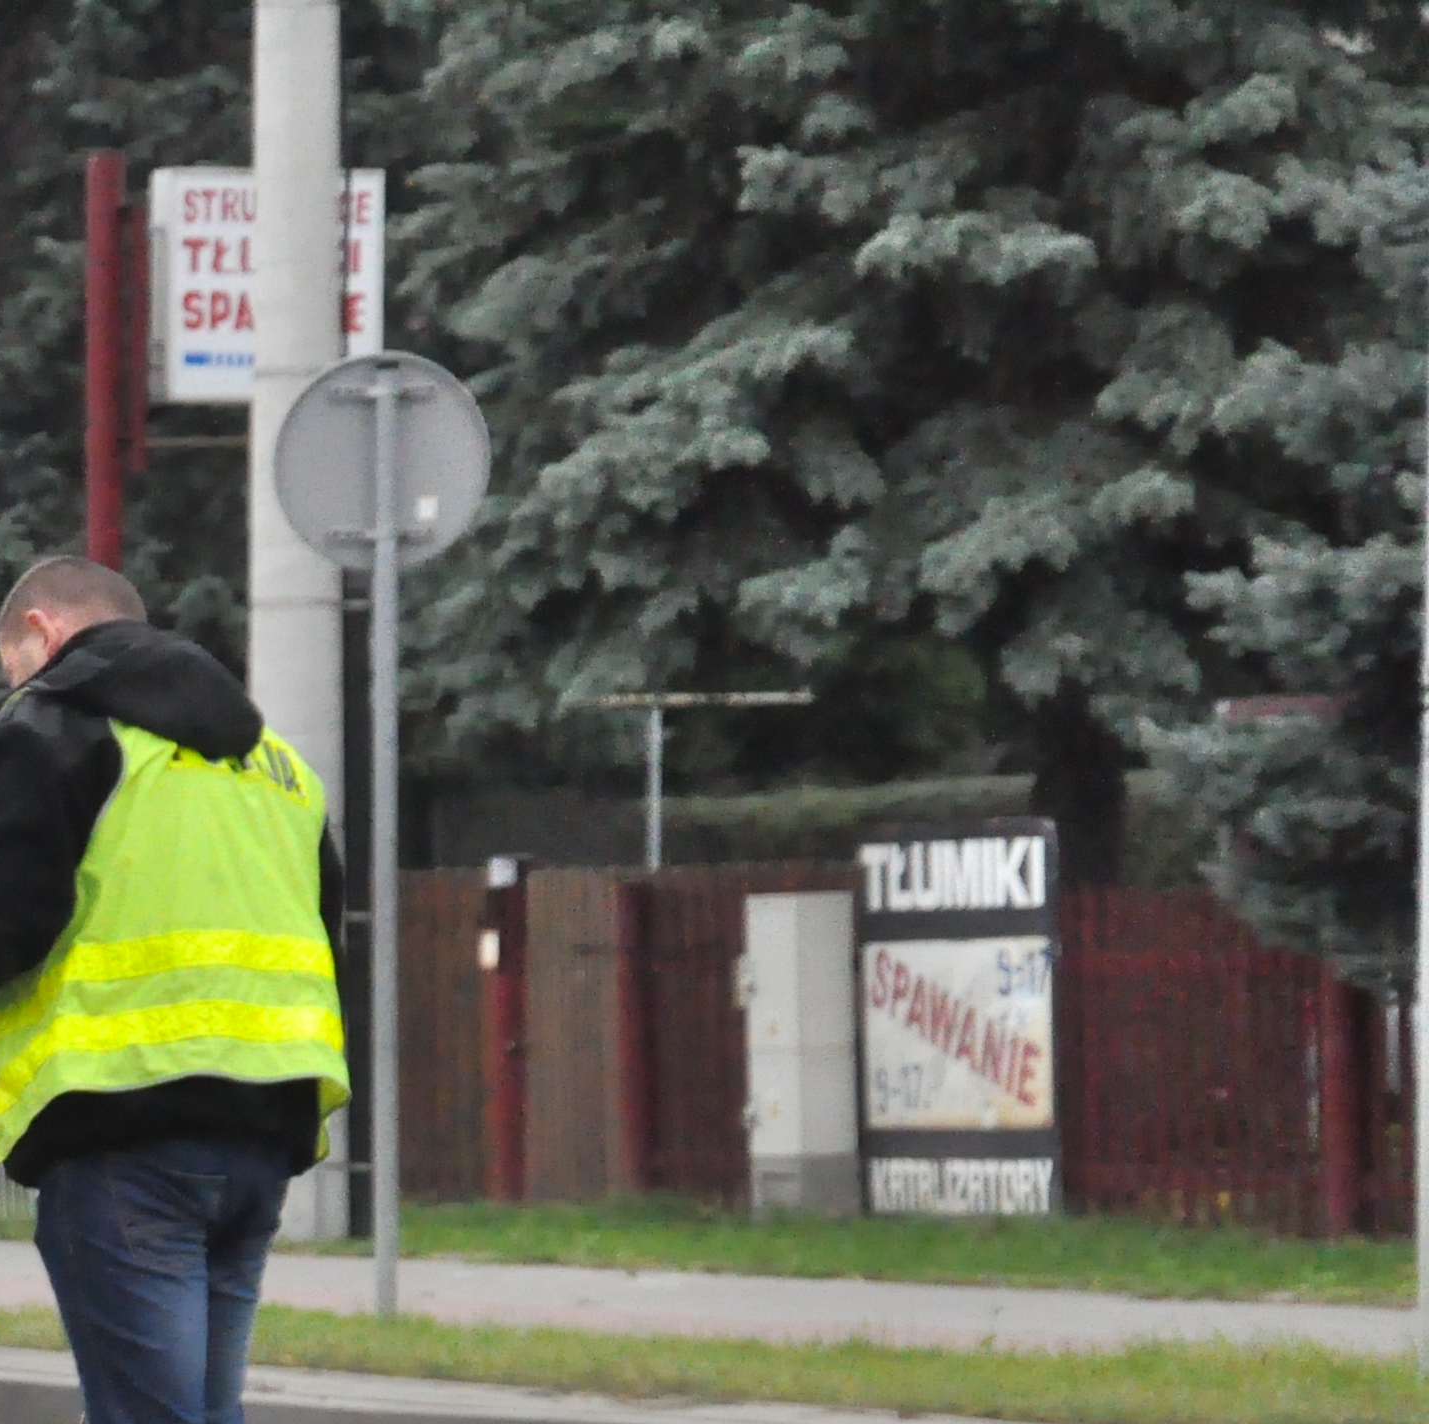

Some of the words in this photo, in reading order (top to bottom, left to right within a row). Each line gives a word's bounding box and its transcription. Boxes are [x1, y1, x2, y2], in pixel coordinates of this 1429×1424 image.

[858, 835, 1046, 912] TŁUMIKI
[870, 947, 1043, 1108] SPAWANIE
[872, 1158, 1053, 1215] KATALIZATORY
